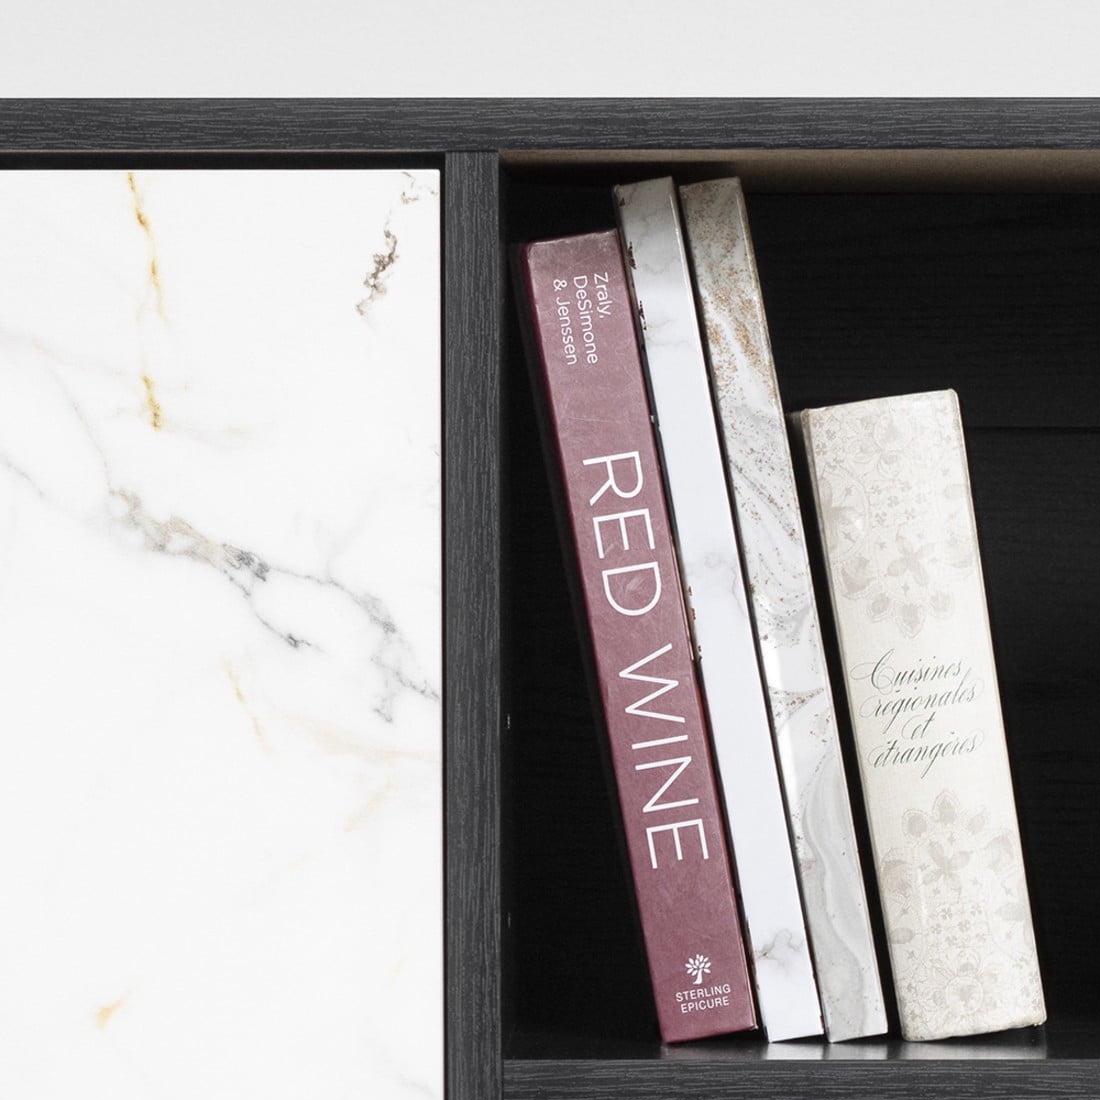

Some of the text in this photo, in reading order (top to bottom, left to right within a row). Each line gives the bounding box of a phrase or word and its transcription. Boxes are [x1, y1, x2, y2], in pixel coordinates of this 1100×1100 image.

[573, 275, 598, 364] DeSimone
[593, 271, 613, 319] Zraly,
[552, 278, 578, 365] & Jenssen
[582, 451, 710, 869] RED WINE
[850, 649, 963, 695] Cuisines
[859, 667, 985, 734] régionales
[901, 711, 937, 741] et
[868, 728, 985, 779] étrangères
[675, 983, 732, 1002] STERLING
[680, 996, 731, 1014] EPICURE
